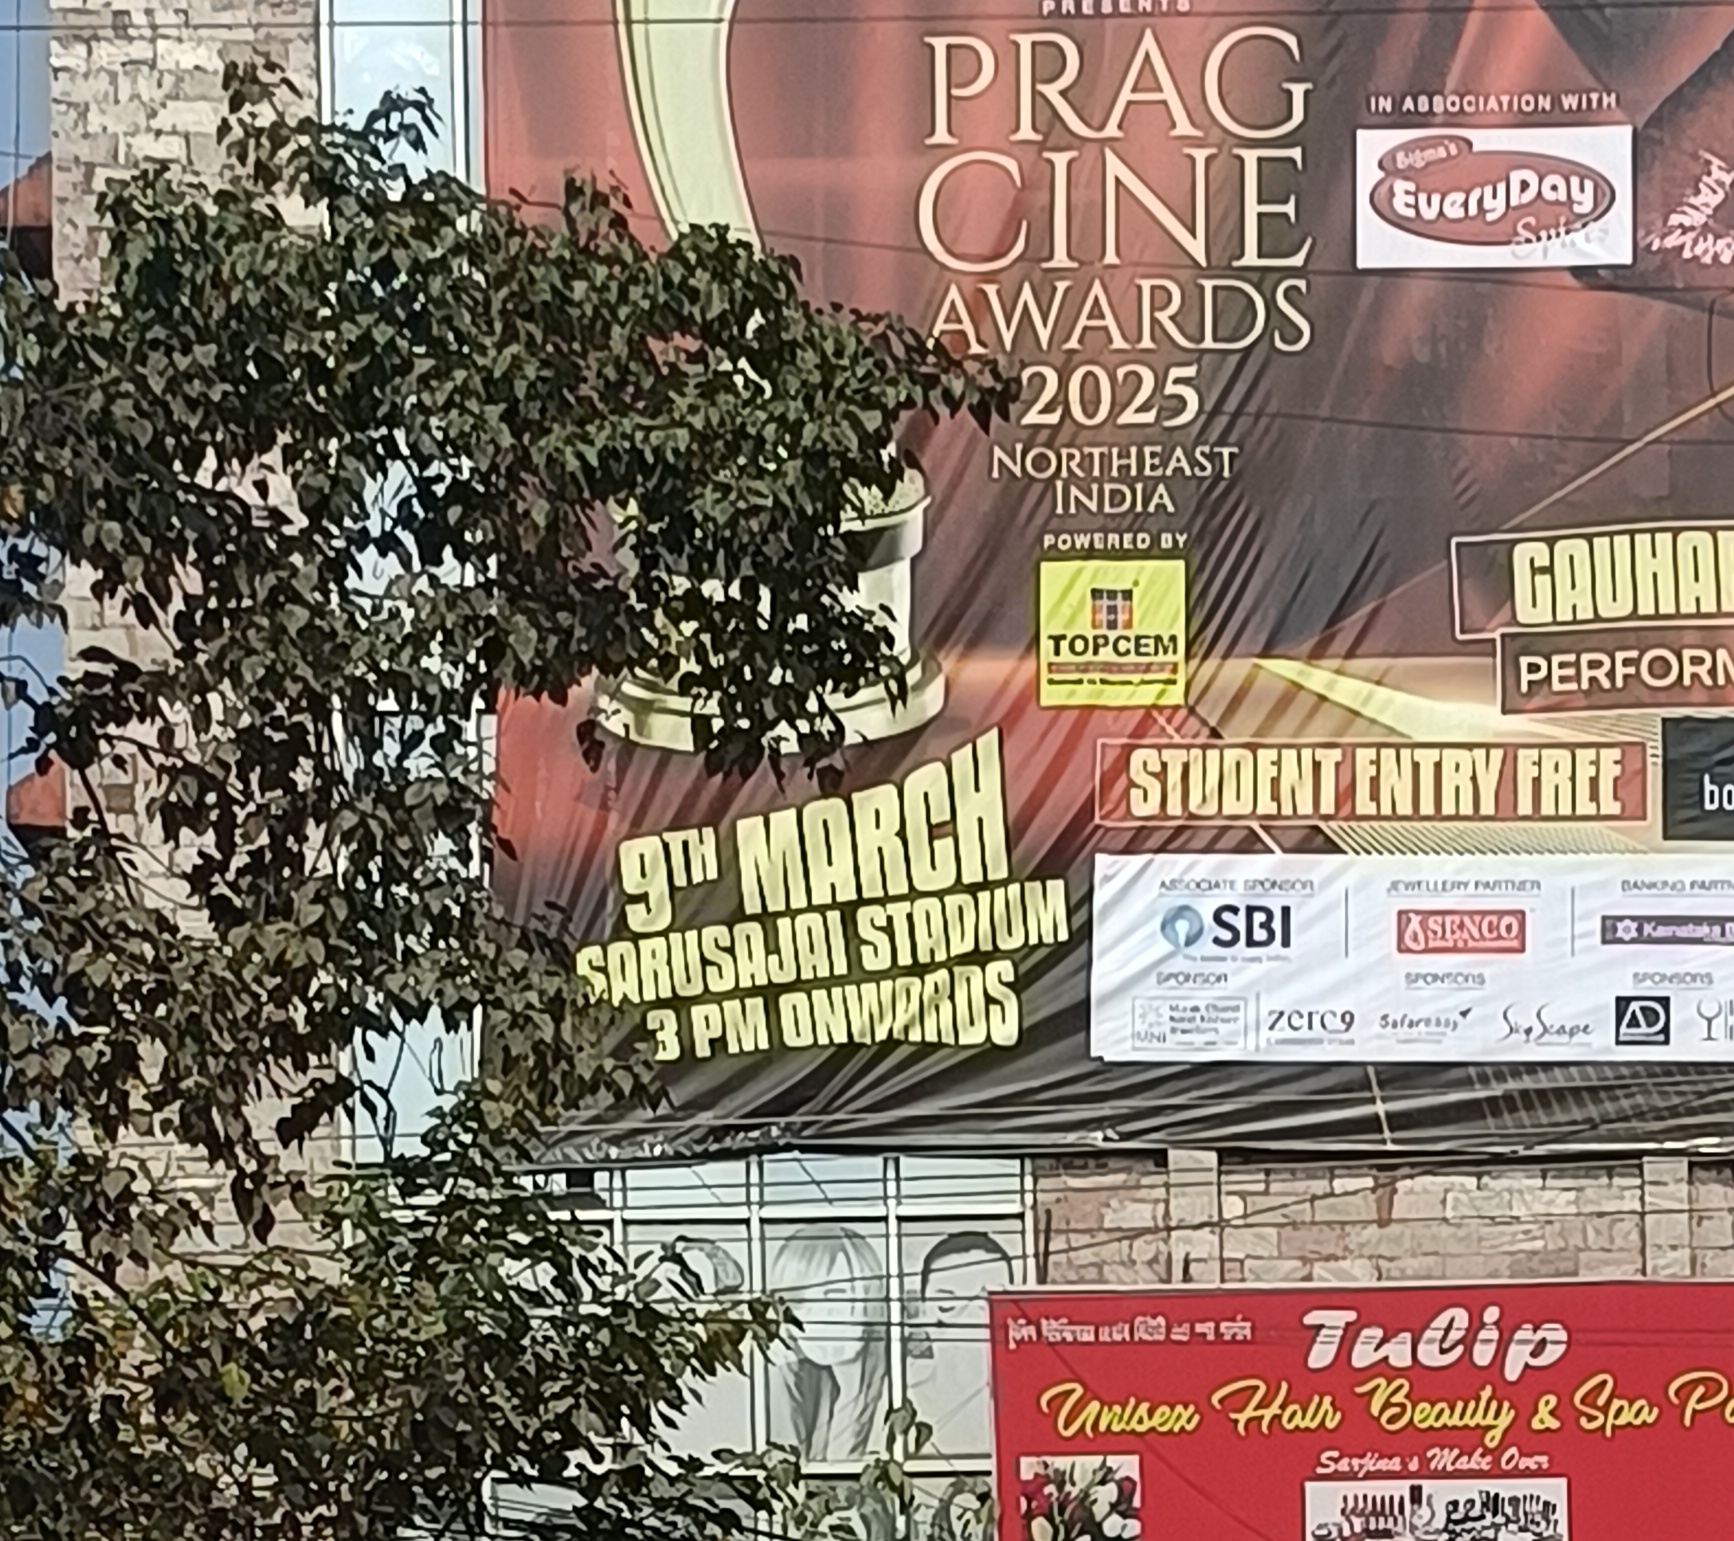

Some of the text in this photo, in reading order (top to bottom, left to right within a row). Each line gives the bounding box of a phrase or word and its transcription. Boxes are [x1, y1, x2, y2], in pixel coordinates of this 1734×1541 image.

[923, 25, 1314, 146] PRAG
[1369, 92, 1618, 114] IN ASSOCIATION WITH
[917, 146, 1314, 274] CINE
[1391, 168, 1595, 223] EveryDay
[926, 275, 1314, 356] AWARDS
[1019, 362, 1201, 429] 2025
[990, 443, 1240, 481] NORTHEAST
[1053, 483, 1177, 516] INDIA
[1042, 532, 1189, 551] POWERED BY
[1046, 633, 1179, 658] TOPCEM
[1128, 745, 1624, 819] STUDENT ENTRY FREE
[618, 726, 1009, 934] 9TH MARCH
[576, 878, 1070, 1008] SARUSAJAI STADIUM
[1210, 903, 1292, 949] SBI
[1426, 915, 1520, 941] SENCO
[646, 959, 1020, 1062] 3 PM ONWARDS
[1301, 1304, 1569, 1383] Tulip
[1038, 1381, 1201, 1442] Unisex
[1210, 1376, 1343, 1439] Hair
[1353, 1376, 1517, 1450] Beauty
[1530, 1393, 1562, 1431] &
[1573, 1372, 1660, 1439] Spa
[1425, 1446, 1494, 1473] Make
[1500, 1446, 1551, 1473] Over
